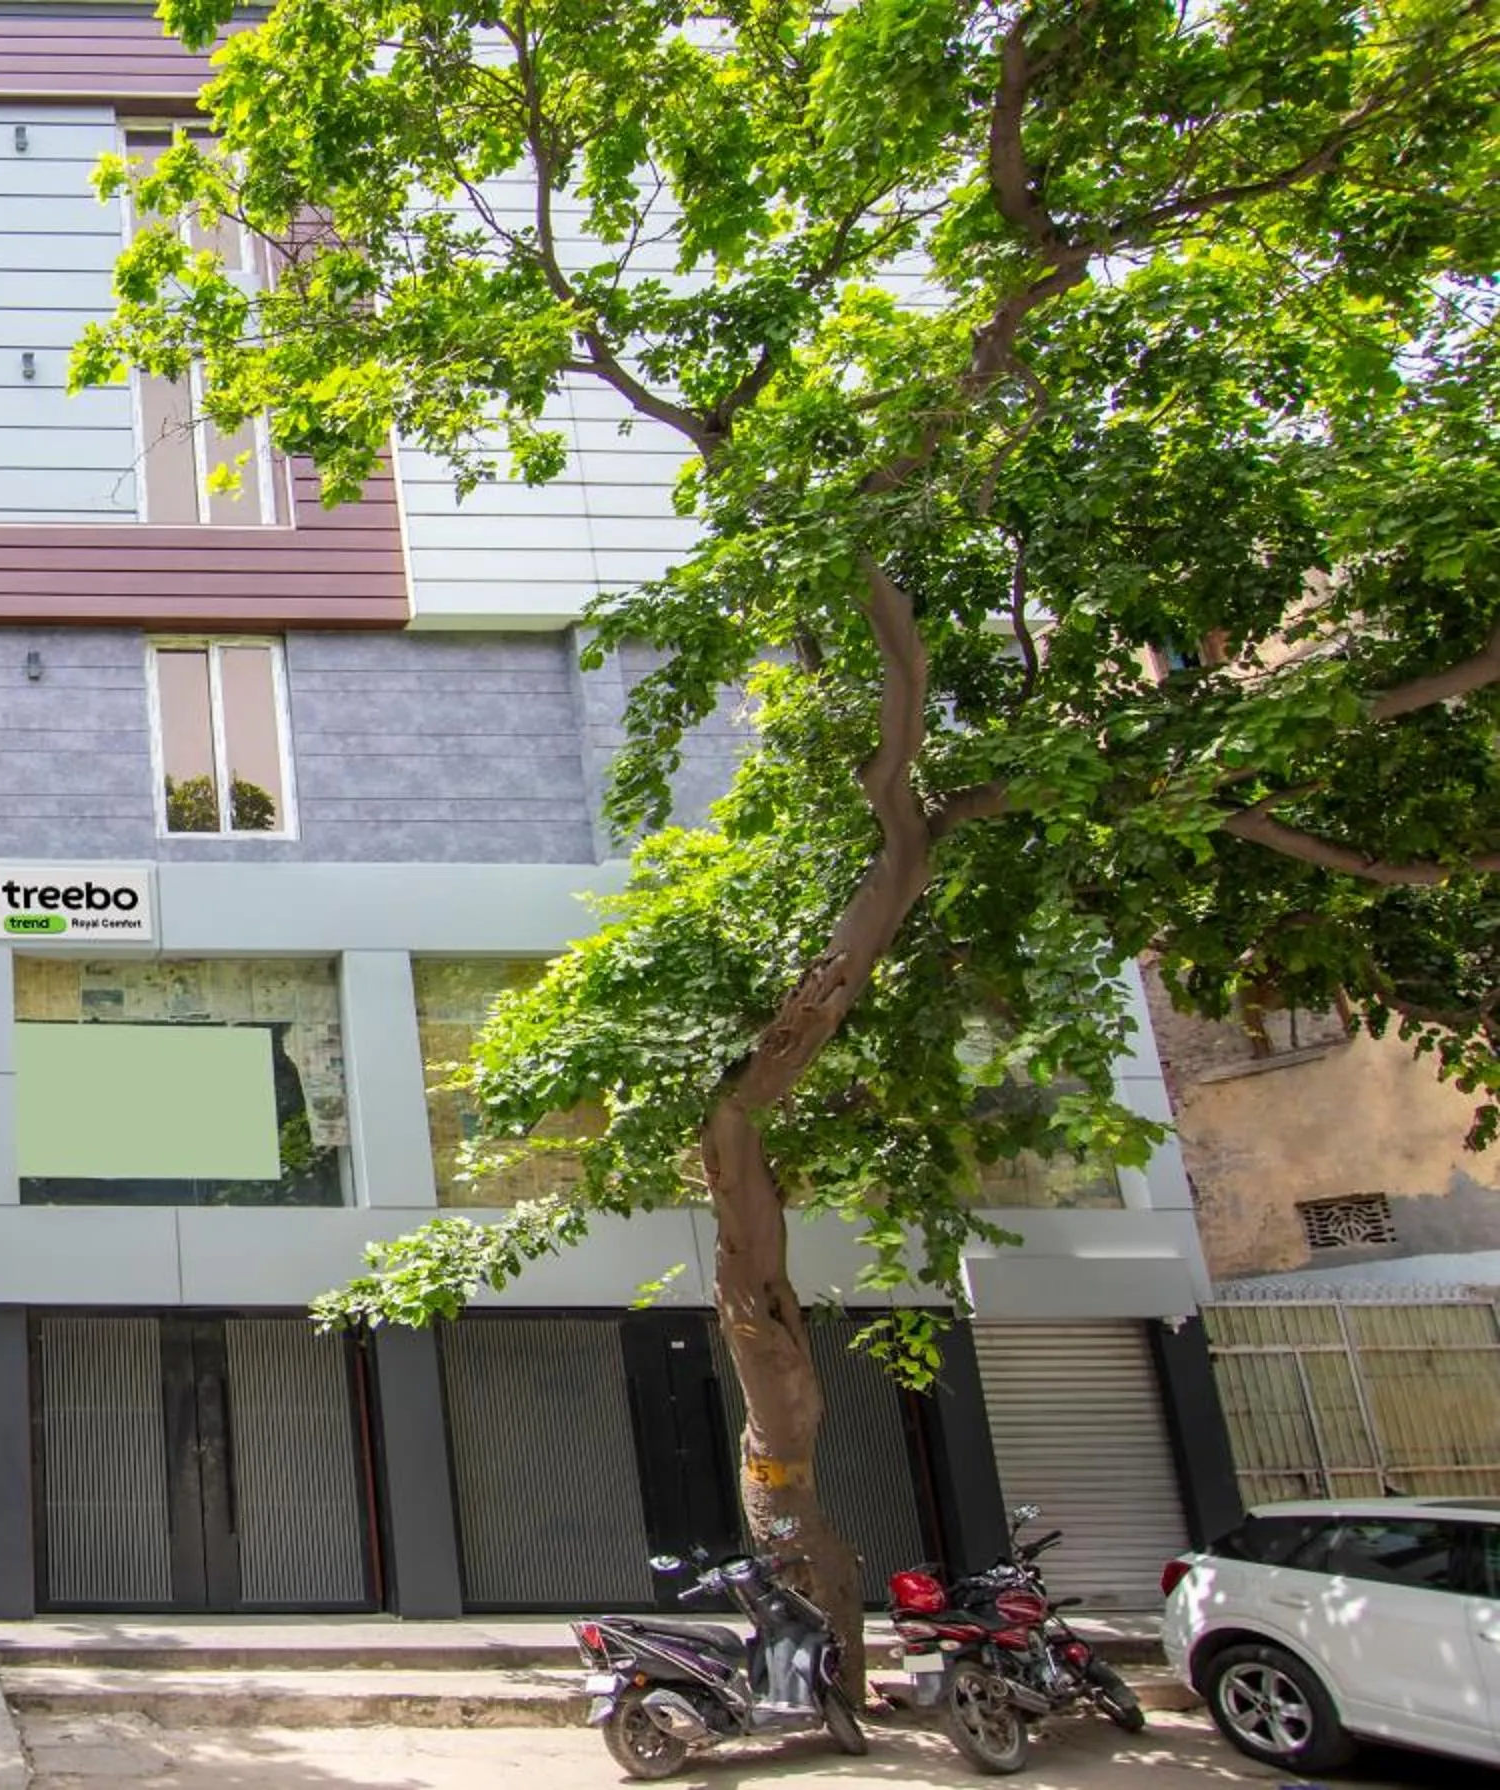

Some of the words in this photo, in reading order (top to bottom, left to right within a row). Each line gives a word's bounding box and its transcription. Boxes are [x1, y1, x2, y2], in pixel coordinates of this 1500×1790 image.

[1, 880, 139, 911] treebo
[9, 917, 50, 929] trend
[71, 918, 99, 930] Royal
[102, 918, 142, 929] Comfort
